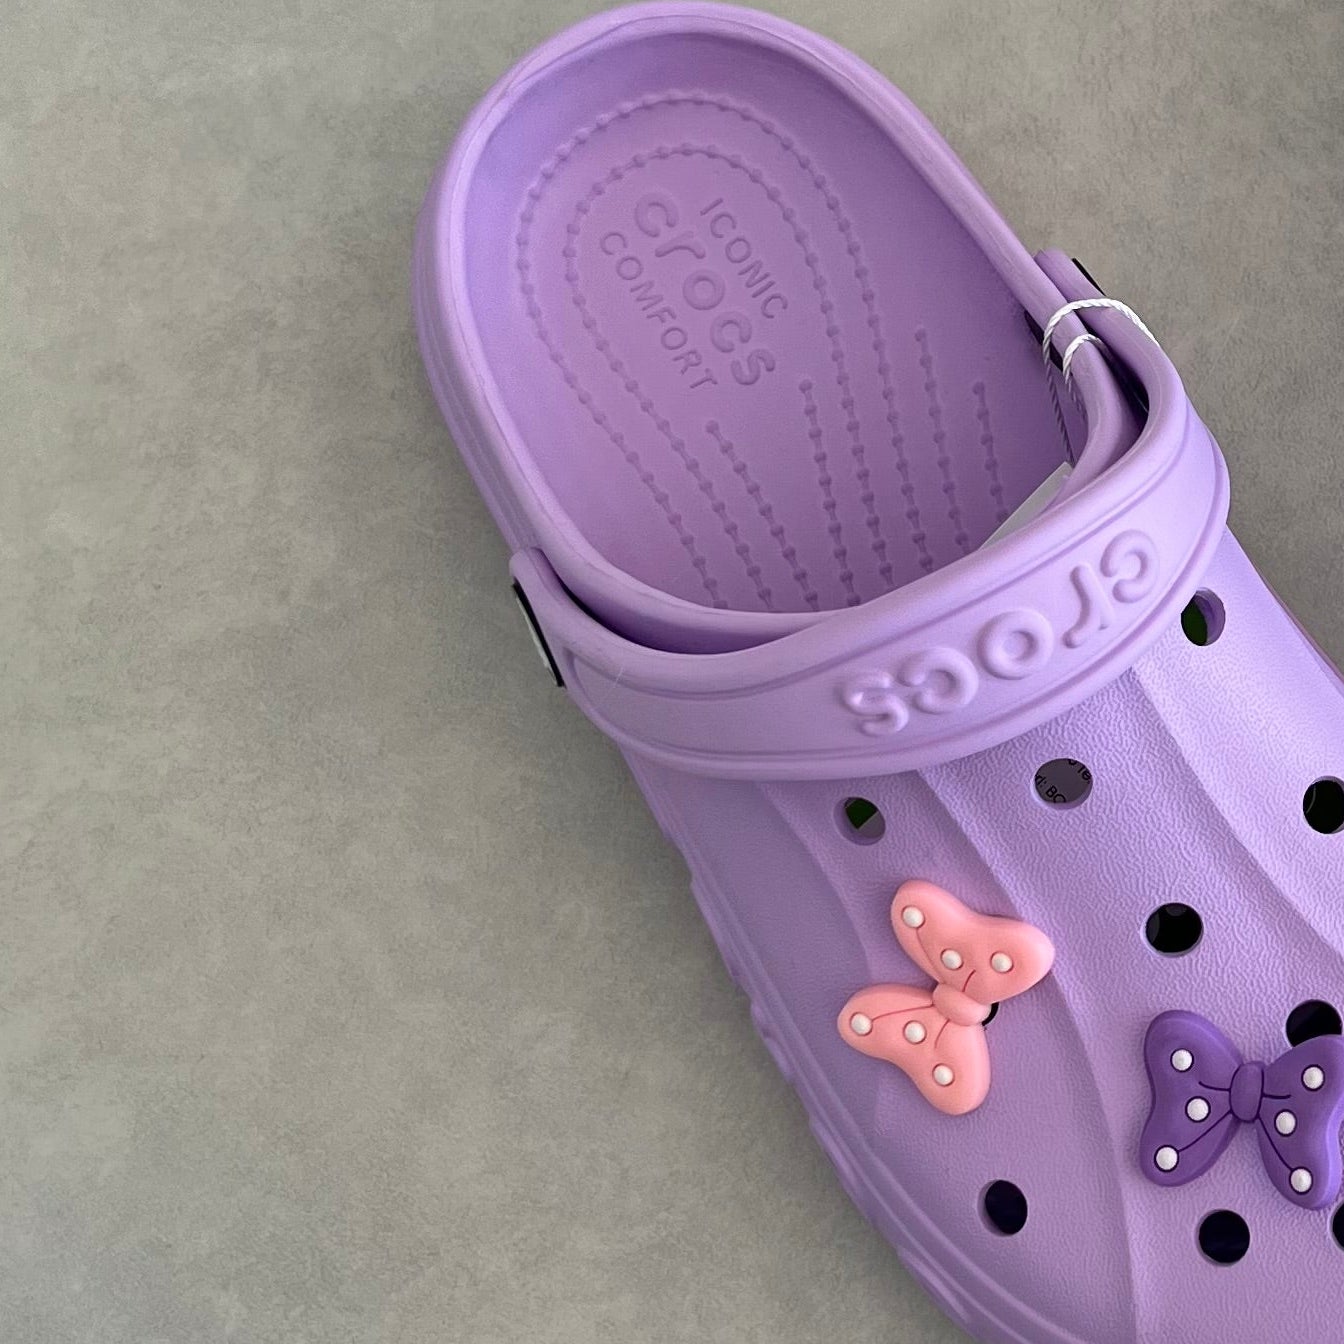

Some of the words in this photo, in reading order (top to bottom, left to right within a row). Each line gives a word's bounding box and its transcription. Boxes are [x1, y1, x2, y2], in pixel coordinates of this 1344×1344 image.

[601, 232, 718, 388] COMFORT
[634, 192, 776, 386] crocs
[700, 198, 788, 318] ICONIC
[842, 528, 1157, 737] crocs
